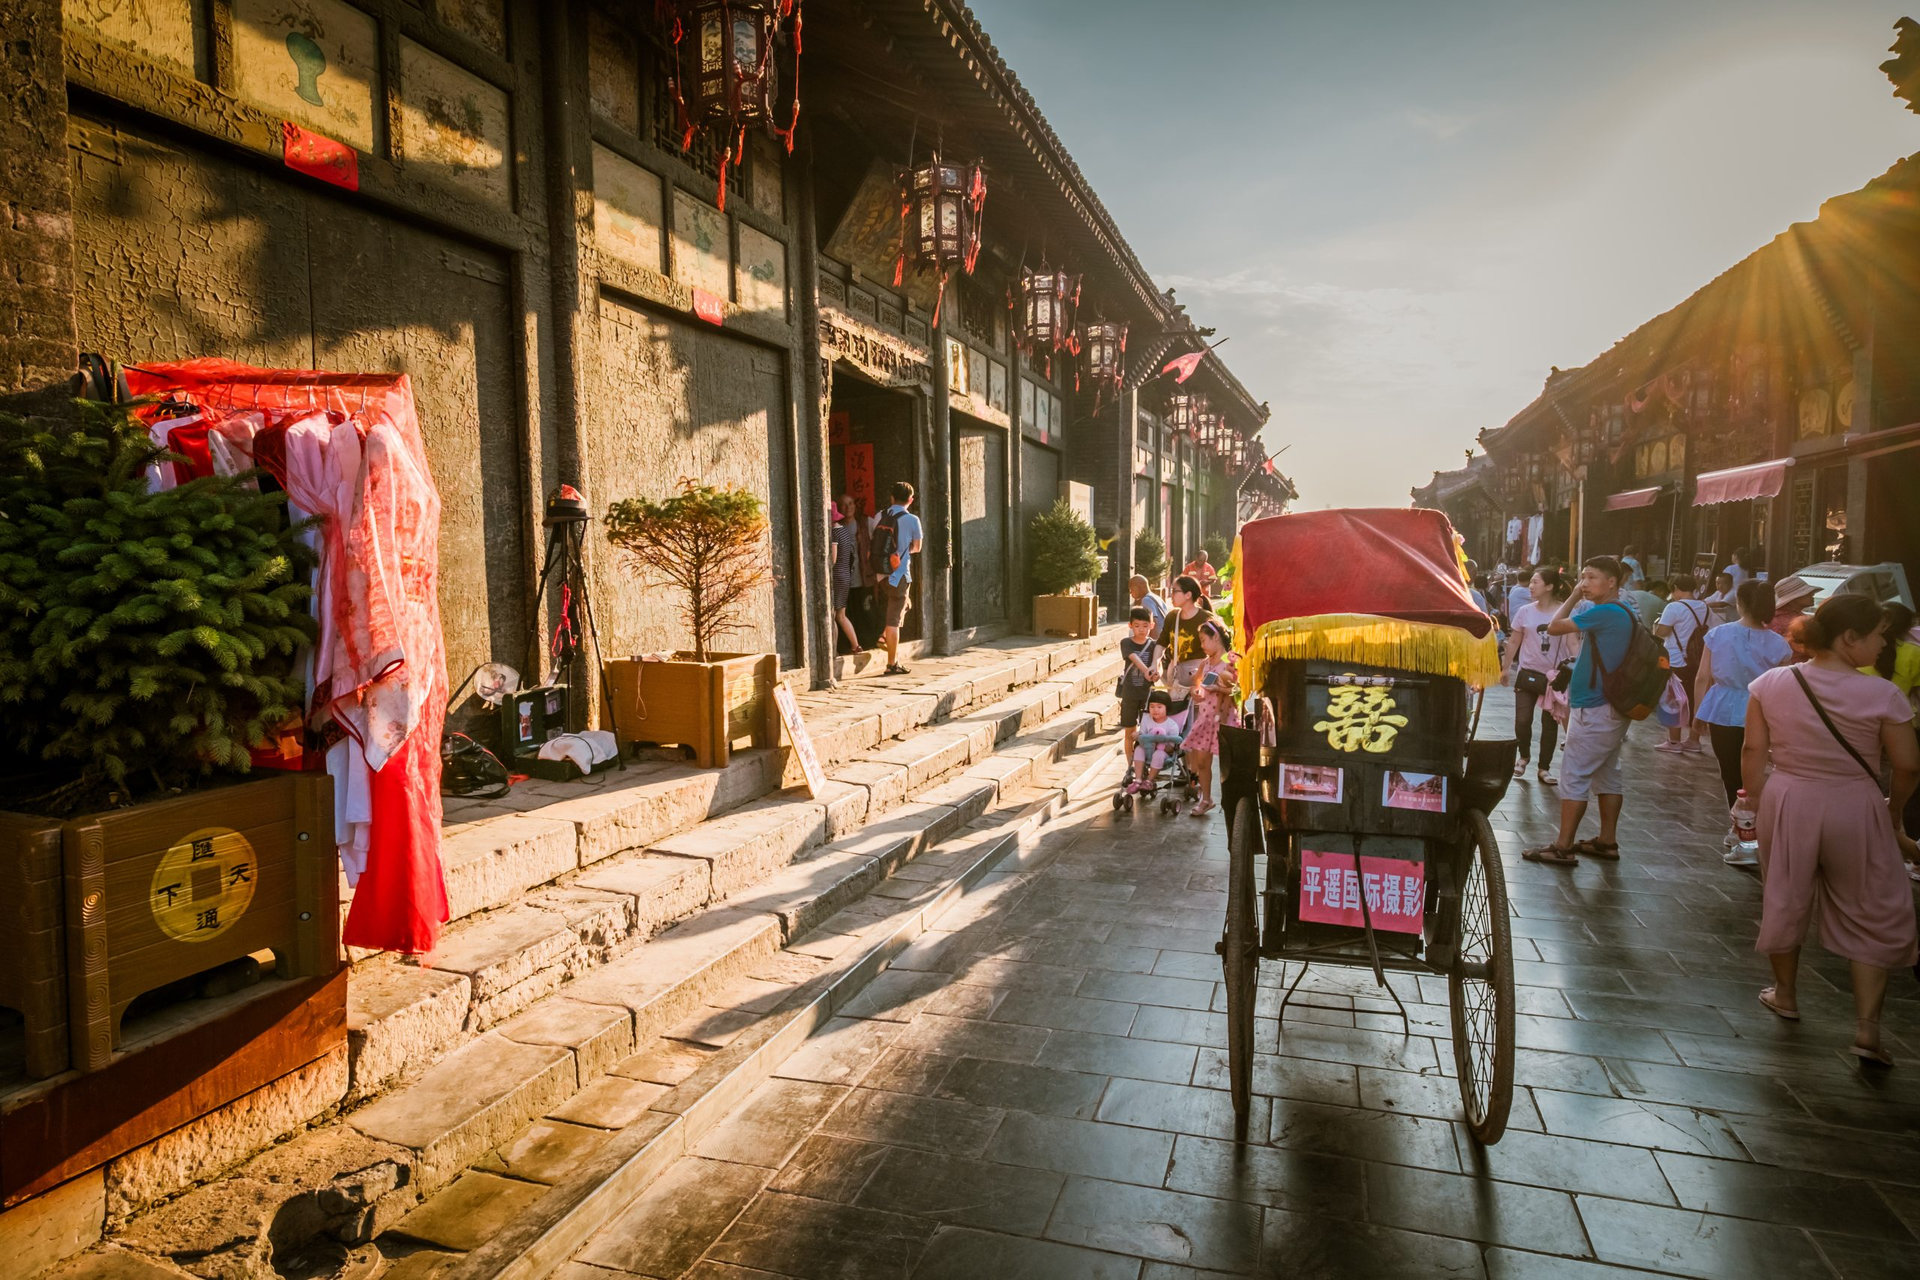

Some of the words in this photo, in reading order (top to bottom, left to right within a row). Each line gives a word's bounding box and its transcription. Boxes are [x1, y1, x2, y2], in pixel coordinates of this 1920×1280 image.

[229, 863, 250, 886] 天
[157, 883, 182, 907] 下
[1303, 865, 1421, 918] 平遥国际摄影
[195, 907, 220, 931] 通
